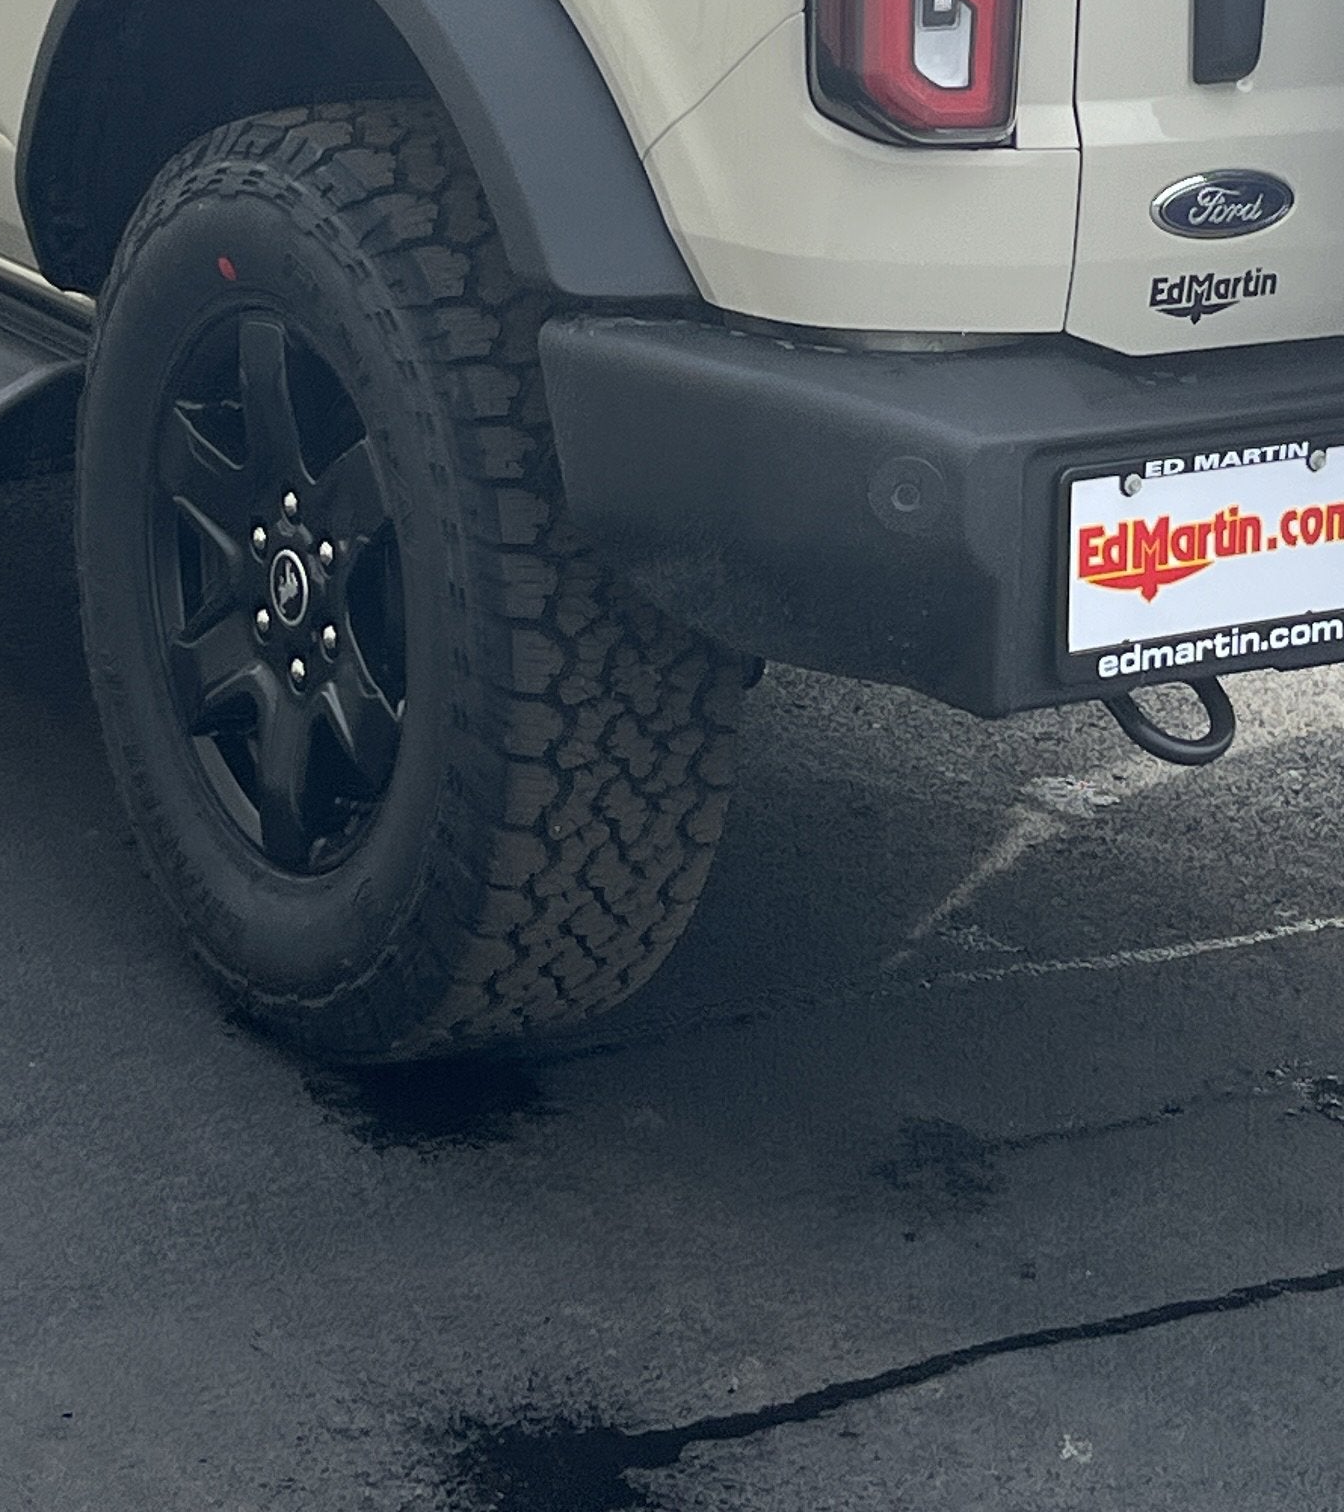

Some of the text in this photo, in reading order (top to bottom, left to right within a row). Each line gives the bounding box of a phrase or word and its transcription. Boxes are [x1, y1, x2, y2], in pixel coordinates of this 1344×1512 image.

[1187, 186, 1265, 226] Ford
[1149, 266, 1278, 308] EdMartin
[1144, 441, 1310, 479] ED MARTIN
[1097, 618, 1344, 678] edmartin.com
